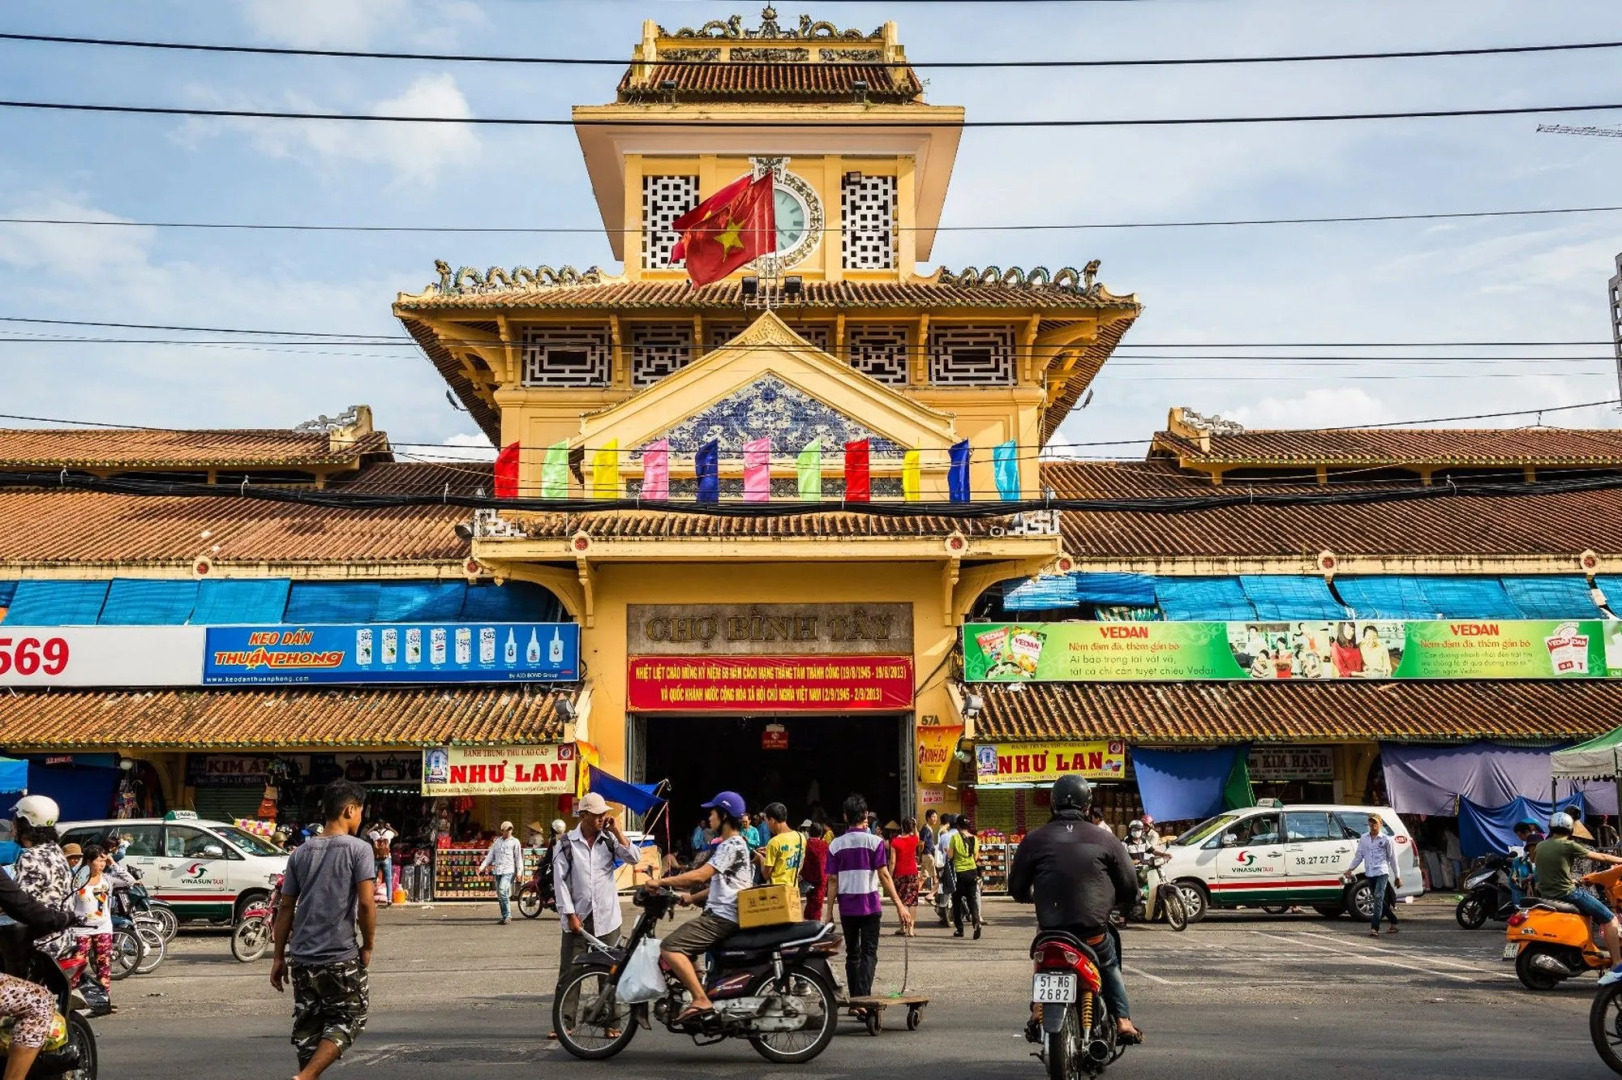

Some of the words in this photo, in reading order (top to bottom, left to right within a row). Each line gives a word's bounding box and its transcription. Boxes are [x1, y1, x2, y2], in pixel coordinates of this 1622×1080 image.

[646, 612, 718, 649] CHỢ
[727, 607, 818, 642] BÌNH
[1100, 626, 1149, 639] VEDAN
[1450, 624, 1500, 636] VEDAN
[248, 631, 281, 646] KEO
[281, 628, 315, 646] DÁN
[1015, 637, 1040, 650] VEDAN
[1070, 655, 1080, 664] Ai
[921, 715, 940, 726] 57A
[483, 748, 506, 757] TRUNG
[507, 748, 520, 757] THU
[521, 748, 535, 756] CAO
[207, 760, 246, 773] KIM
[998, 750, 1049, 774] NHƯ
[1056, 752, 1103, 771] LAN
[1262, 755, 1287, 768] KIM
[450, 760, 508, 783] NHƯ
[515, 763, 567, 783] LAN
[1295, 856, 1317, 865] 38.27
[1319, 856, 1329, 864] 27
[1331, 855, 1340, 863] 27
[1039, 988, 1070, 1001] 2682
